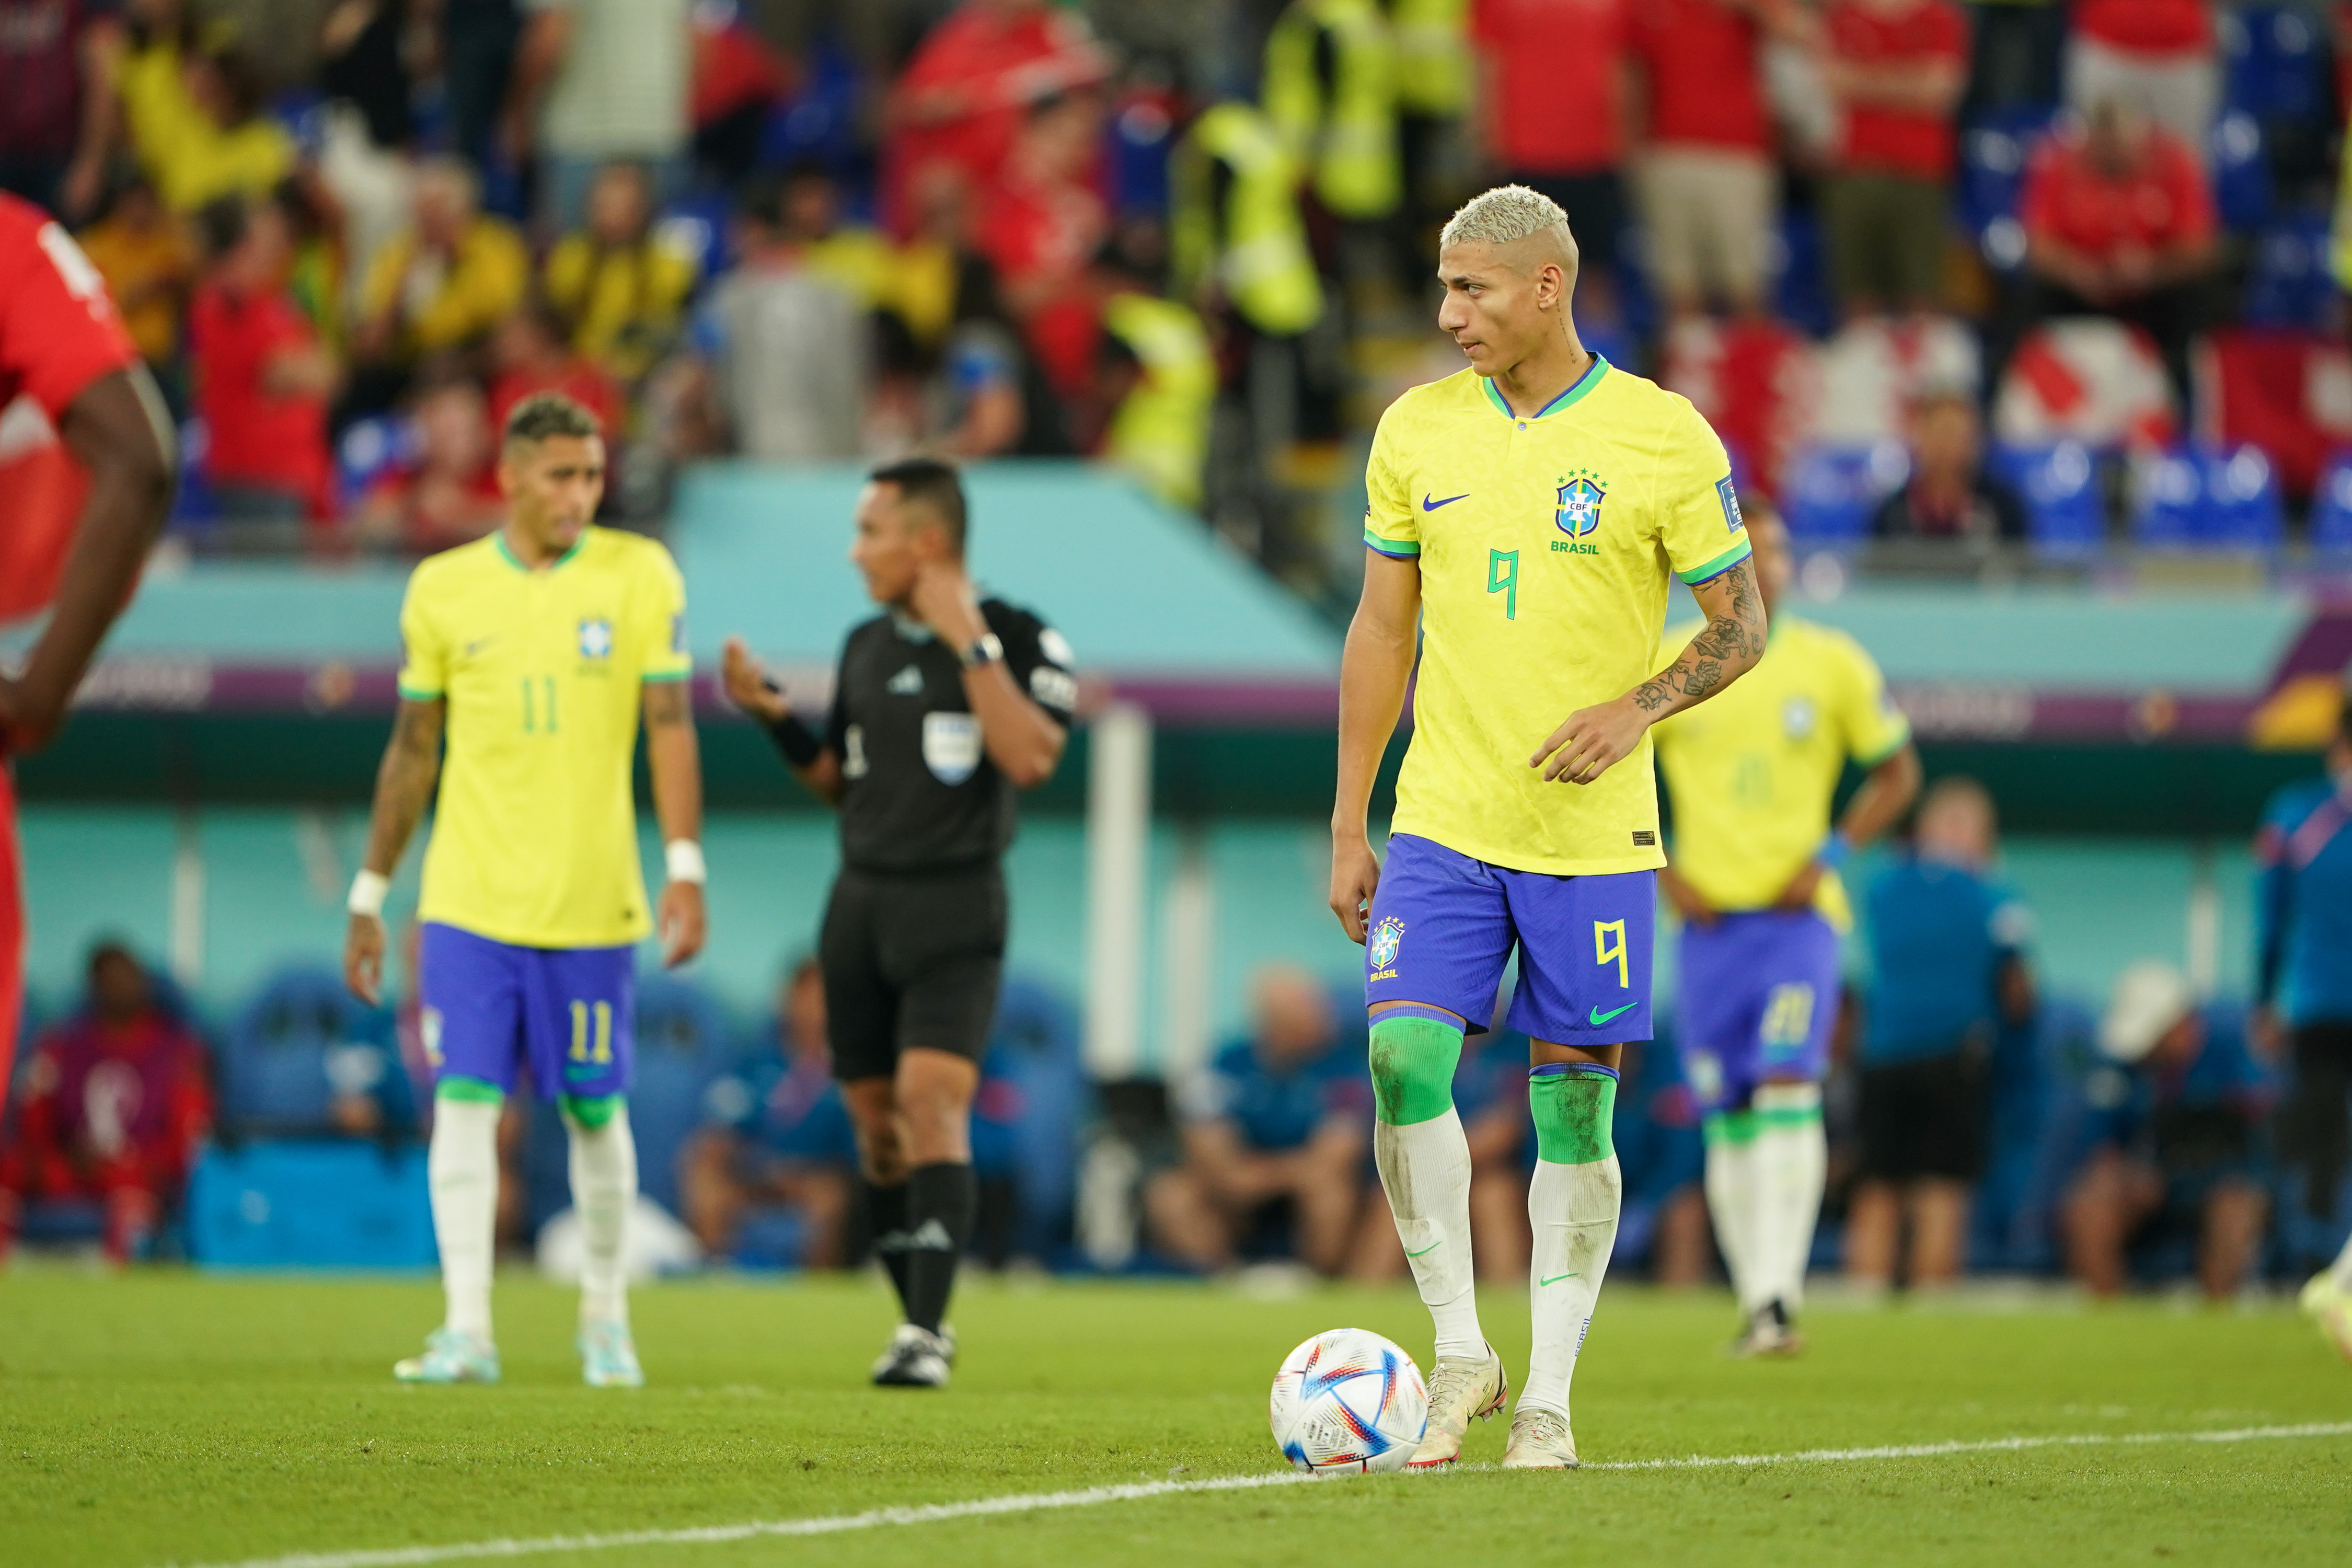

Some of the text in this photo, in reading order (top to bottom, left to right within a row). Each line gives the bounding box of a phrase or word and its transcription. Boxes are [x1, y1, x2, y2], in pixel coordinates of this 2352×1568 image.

[1550, 540, 1599, 555] BRASIL
[1487, 548, 1519, 620] 9
[522, 676, 558, 734] 11
[1370, 969, 1398, 983] BRASIL
[1593, 918, 1629, 989] 9
[567, 999, 614, 1065] 11
